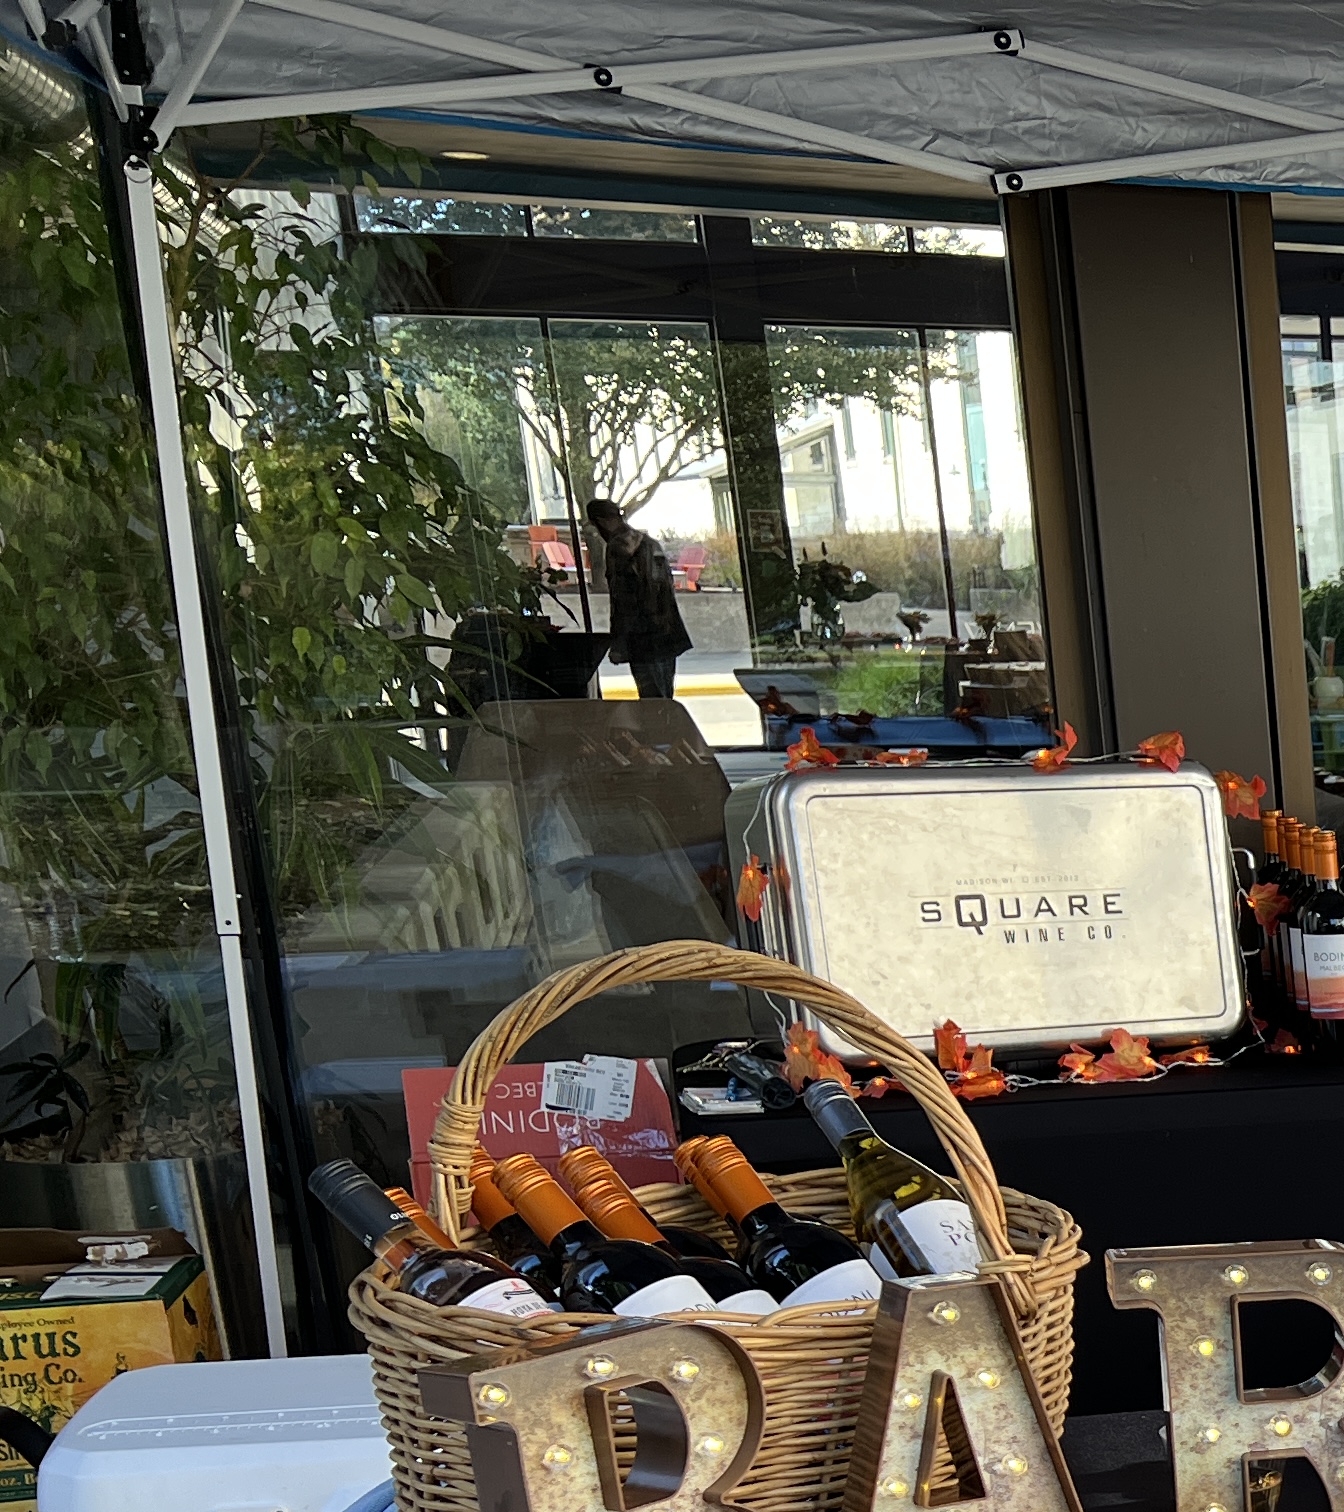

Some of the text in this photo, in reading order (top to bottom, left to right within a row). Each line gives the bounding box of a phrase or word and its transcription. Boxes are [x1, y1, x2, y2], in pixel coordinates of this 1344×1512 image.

[920, 893, 1124, 935] SQUARE
[1004, 924, 1127, 944] WINE CO.
[36, 1316, 75, 1327] Owned
[44, 1362, 85, 1386] Co.
